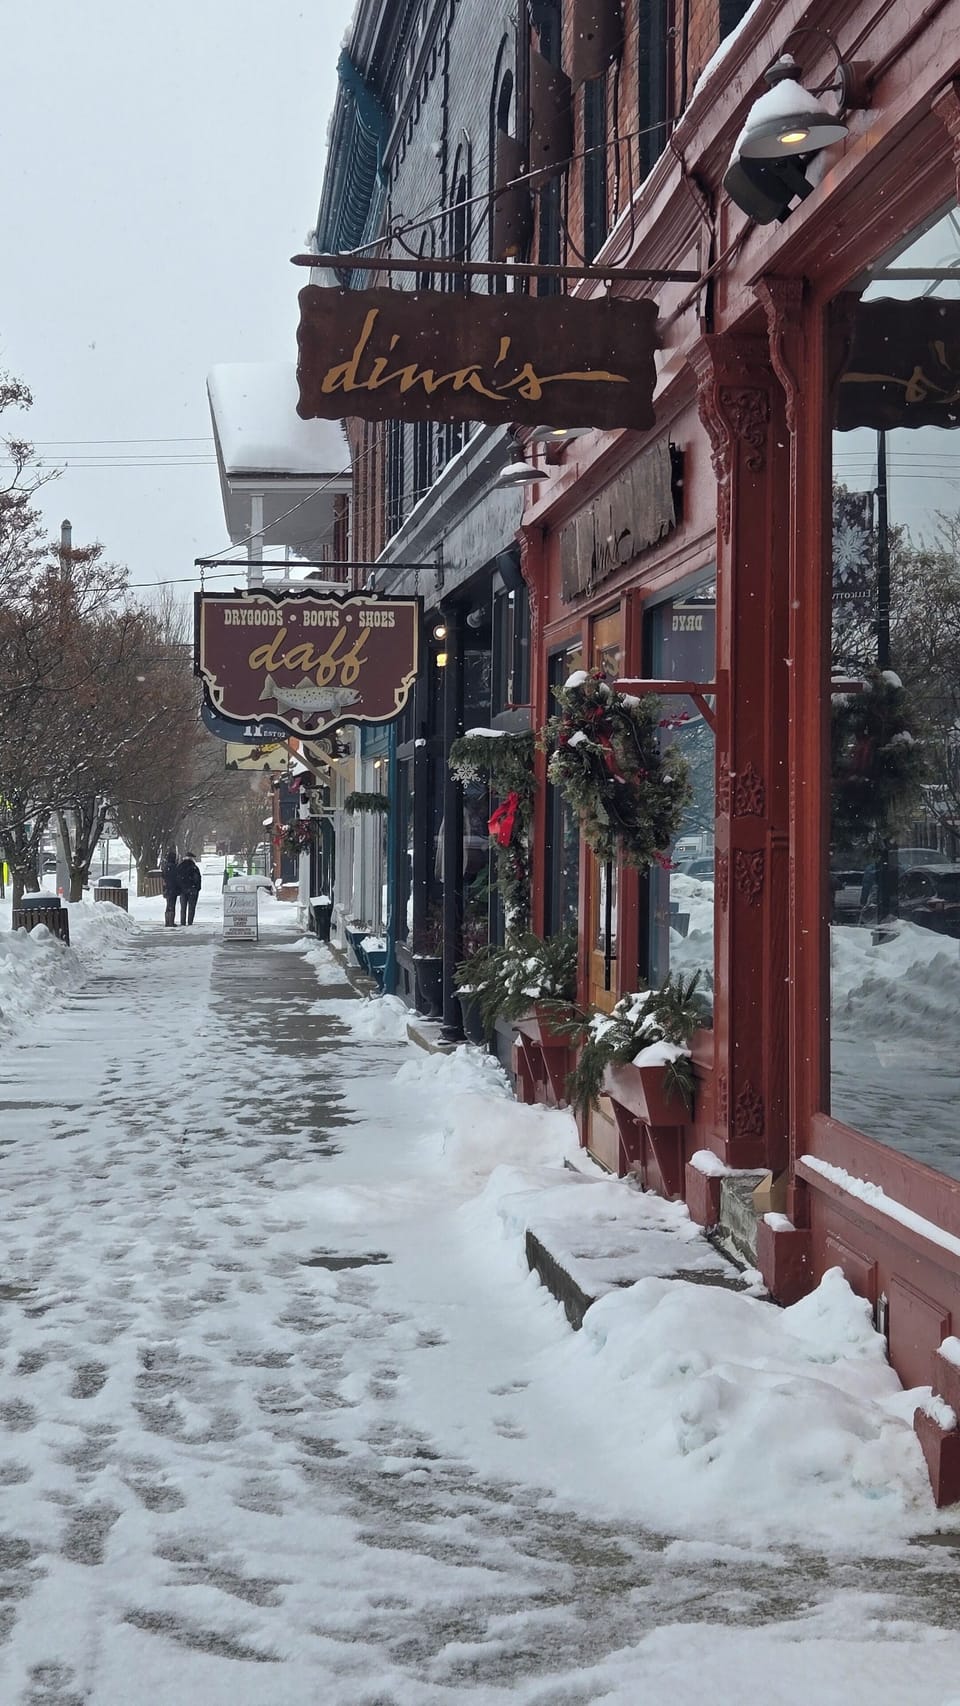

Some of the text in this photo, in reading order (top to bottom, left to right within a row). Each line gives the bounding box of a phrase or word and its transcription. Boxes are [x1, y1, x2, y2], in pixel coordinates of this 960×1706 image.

[321, 308, 630, 400] dina's
[224, 608, 396, 628] DRYGOODS BOOTS SHOES
[248, 625, 371, 687] daff
